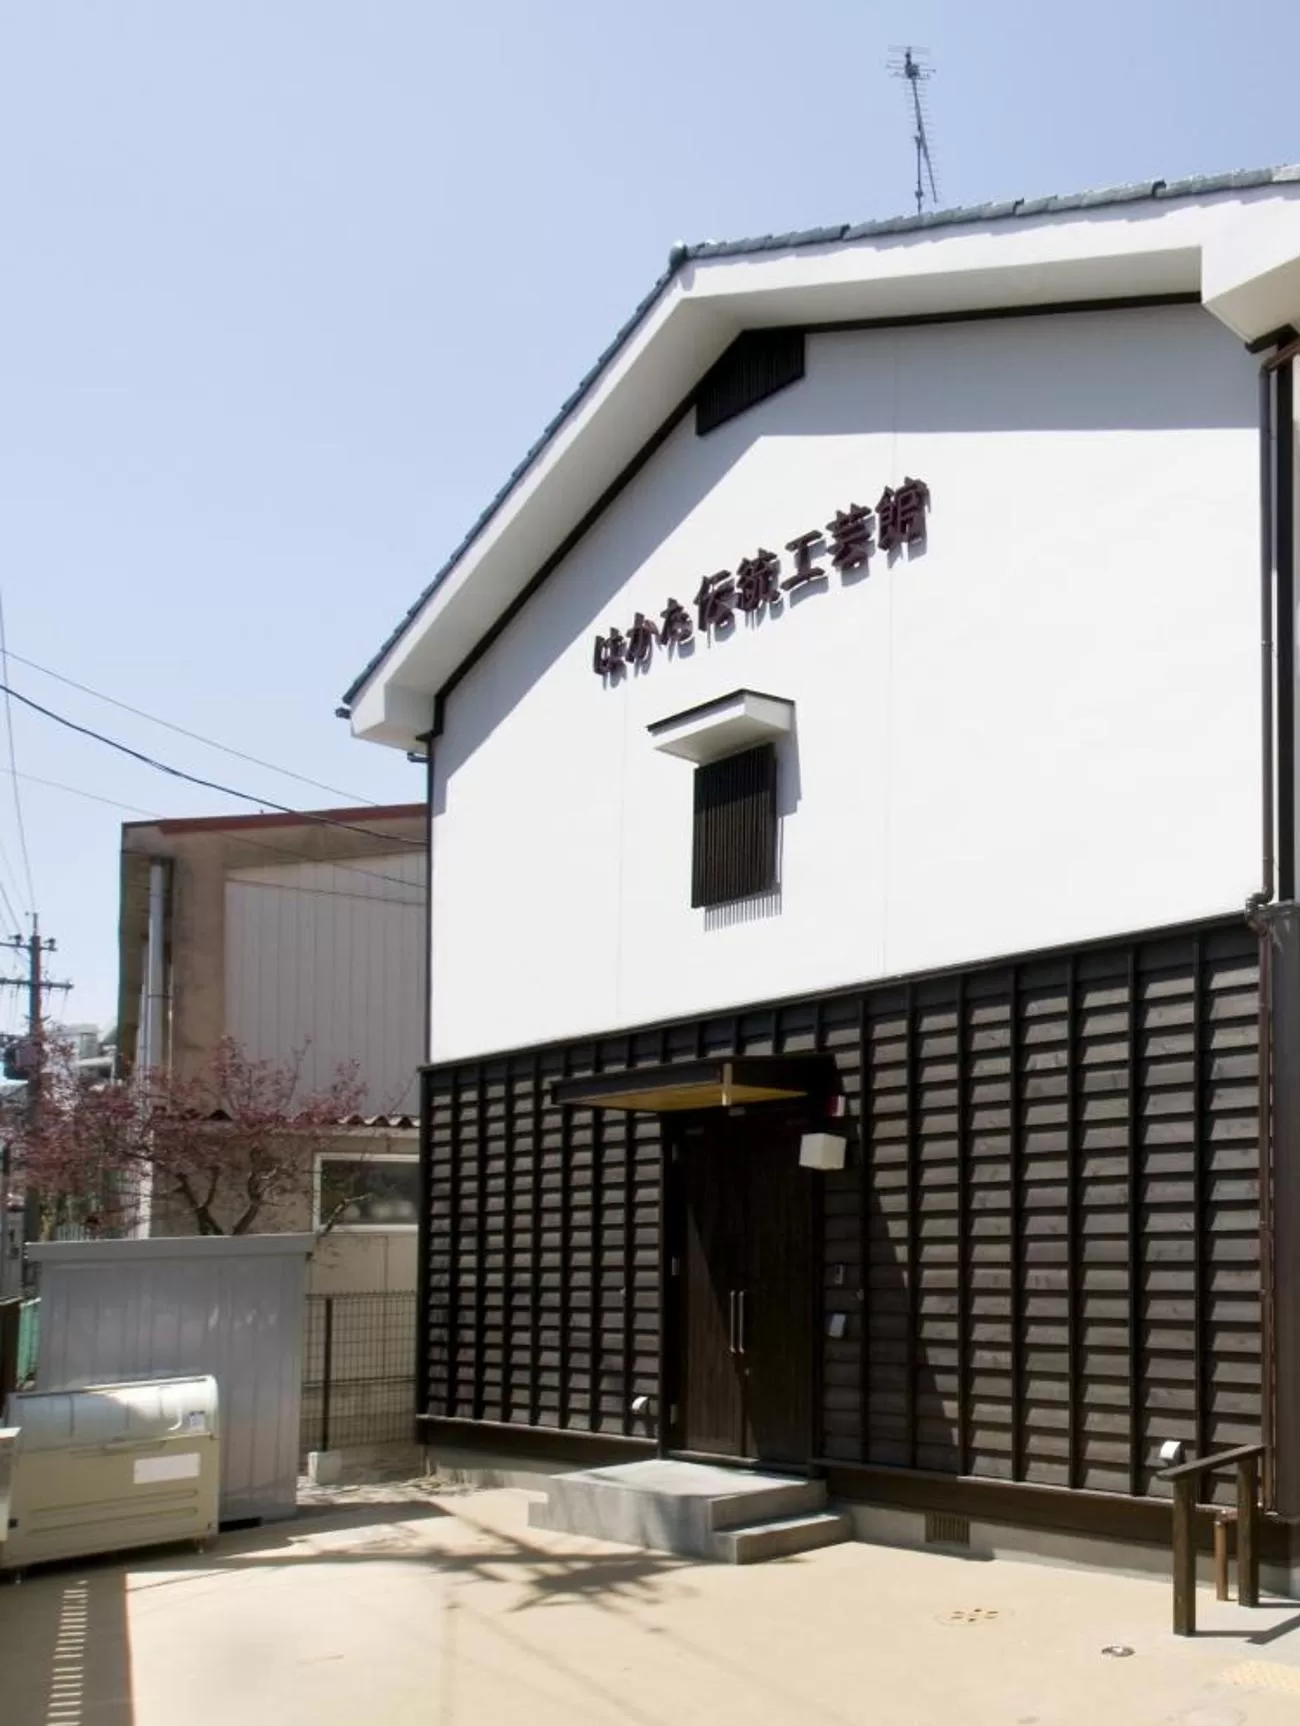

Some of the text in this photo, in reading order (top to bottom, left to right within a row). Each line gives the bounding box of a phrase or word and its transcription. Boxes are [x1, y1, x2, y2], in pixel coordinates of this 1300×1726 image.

[593, 476, 931, 676] はかた伝統工芸館
